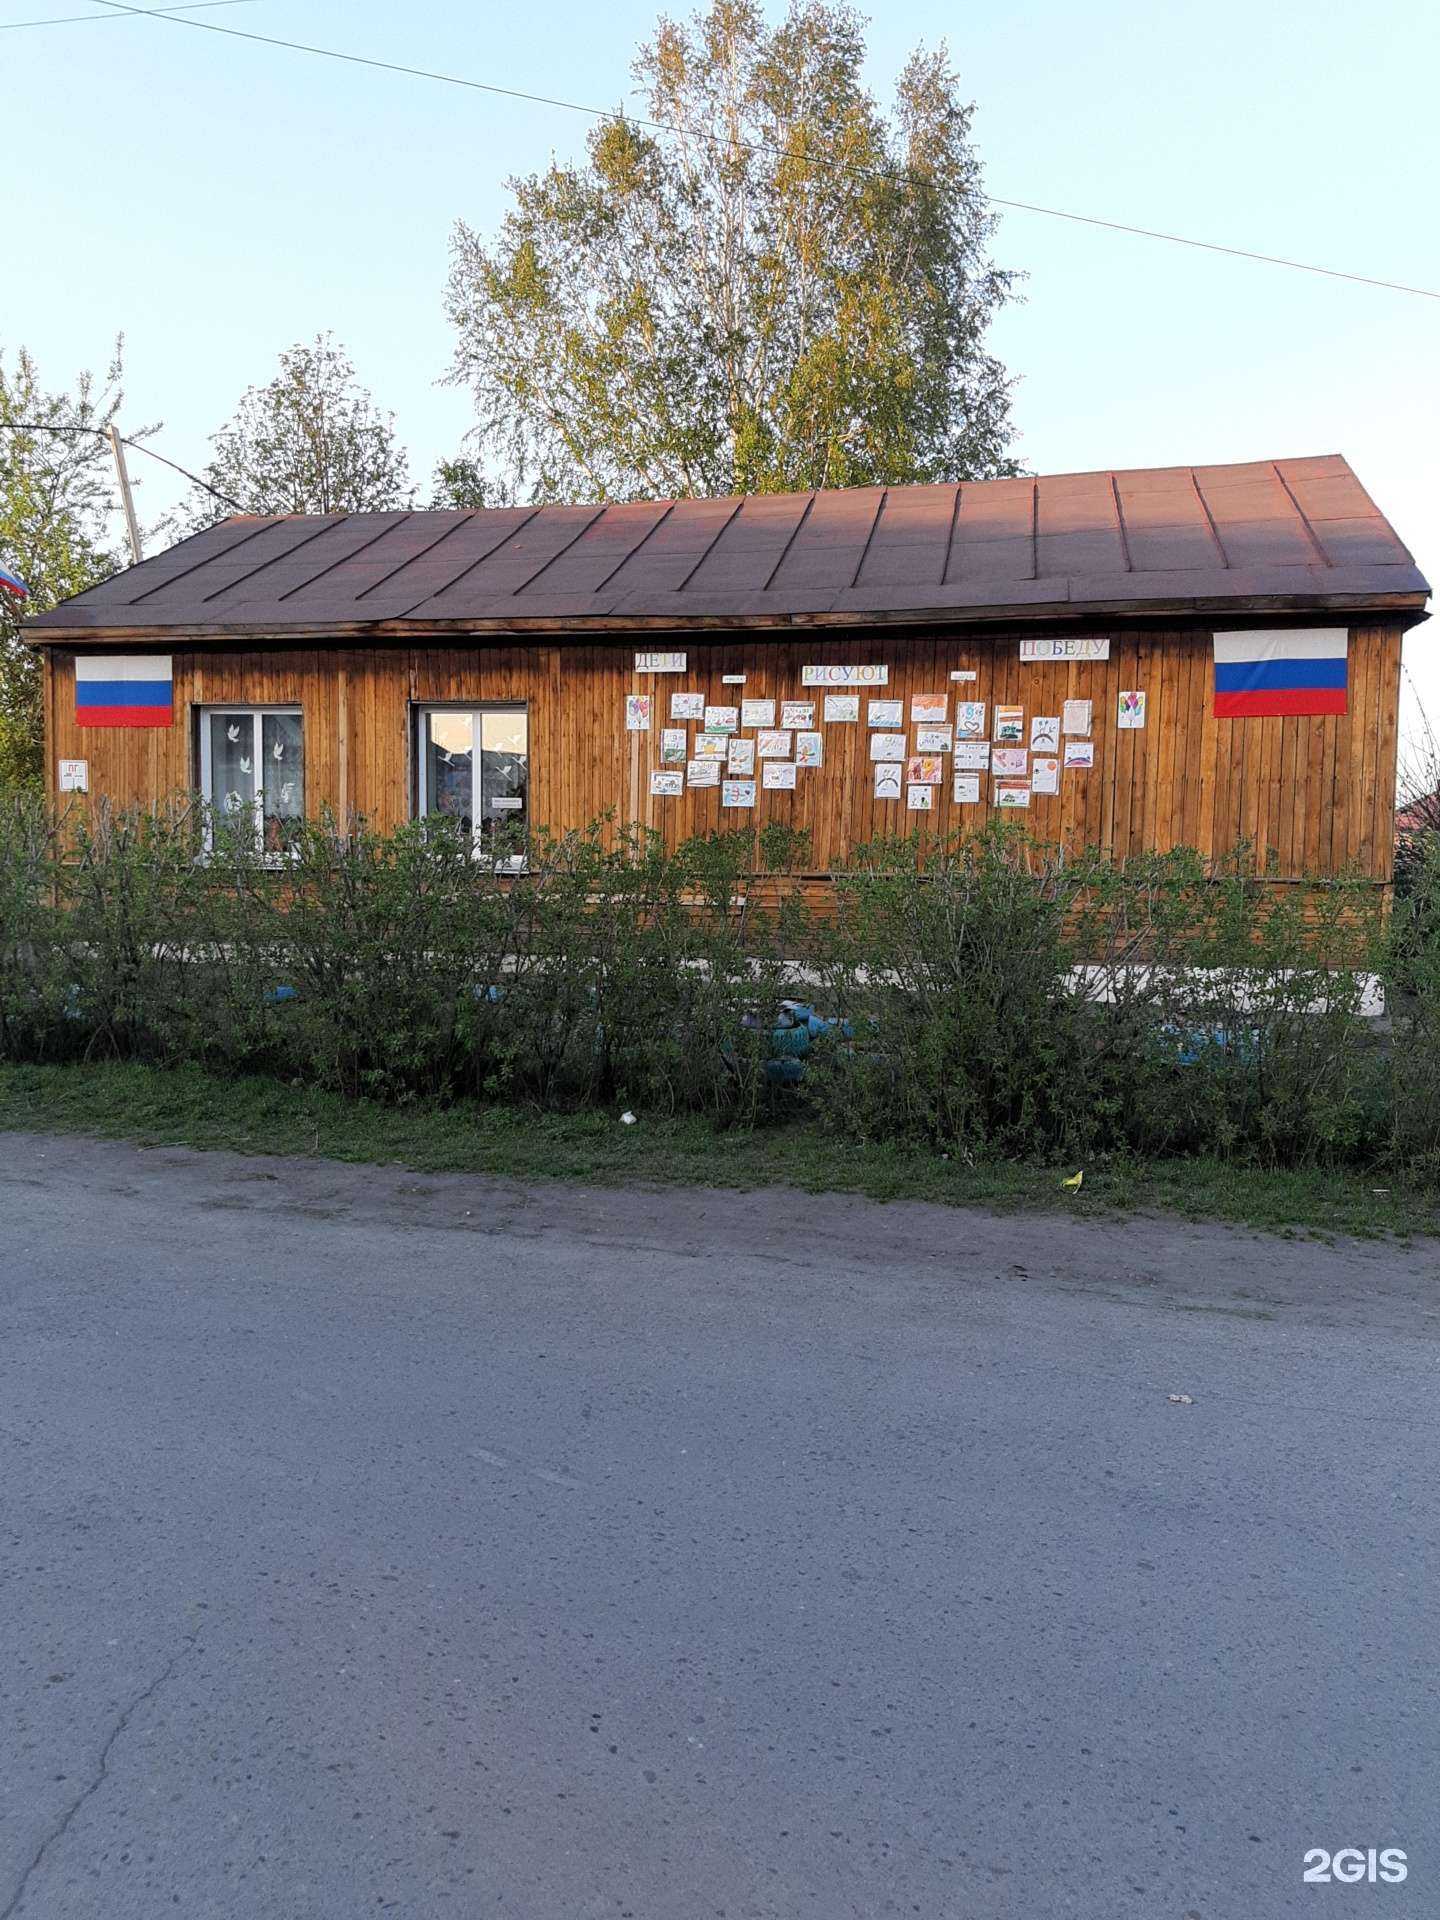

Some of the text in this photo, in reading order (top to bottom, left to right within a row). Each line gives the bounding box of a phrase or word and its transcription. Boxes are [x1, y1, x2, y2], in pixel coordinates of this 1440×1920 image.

[1023, 640, 1106, 657] ПОБЕДУ
[636, 653, 684, 669] ДЕТИ
[804, 666, 886, 681] РИСУЮТ
